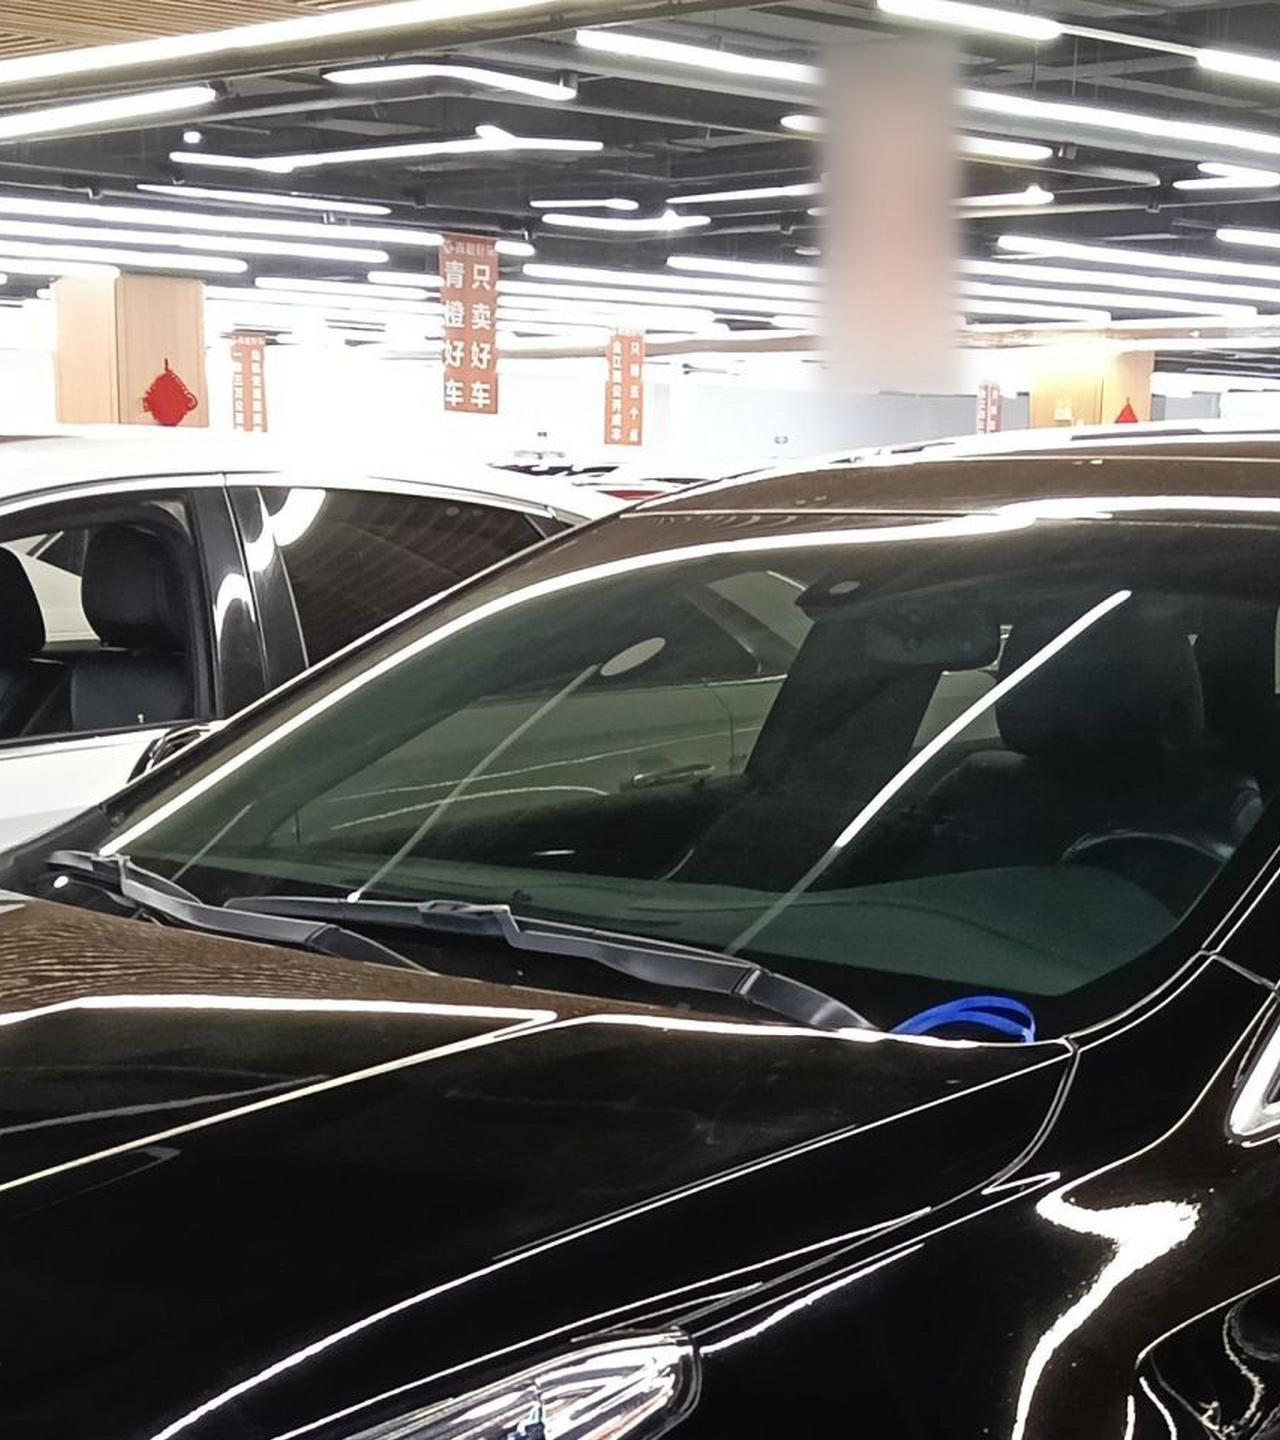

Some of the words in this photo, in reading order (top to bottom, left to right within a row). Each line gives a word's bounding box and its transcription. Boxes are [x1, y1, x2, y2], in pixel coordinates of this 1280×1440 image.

[444, 261, 465, 407] 青橙好车
[471, 265, 492, 408] 只卖好车
